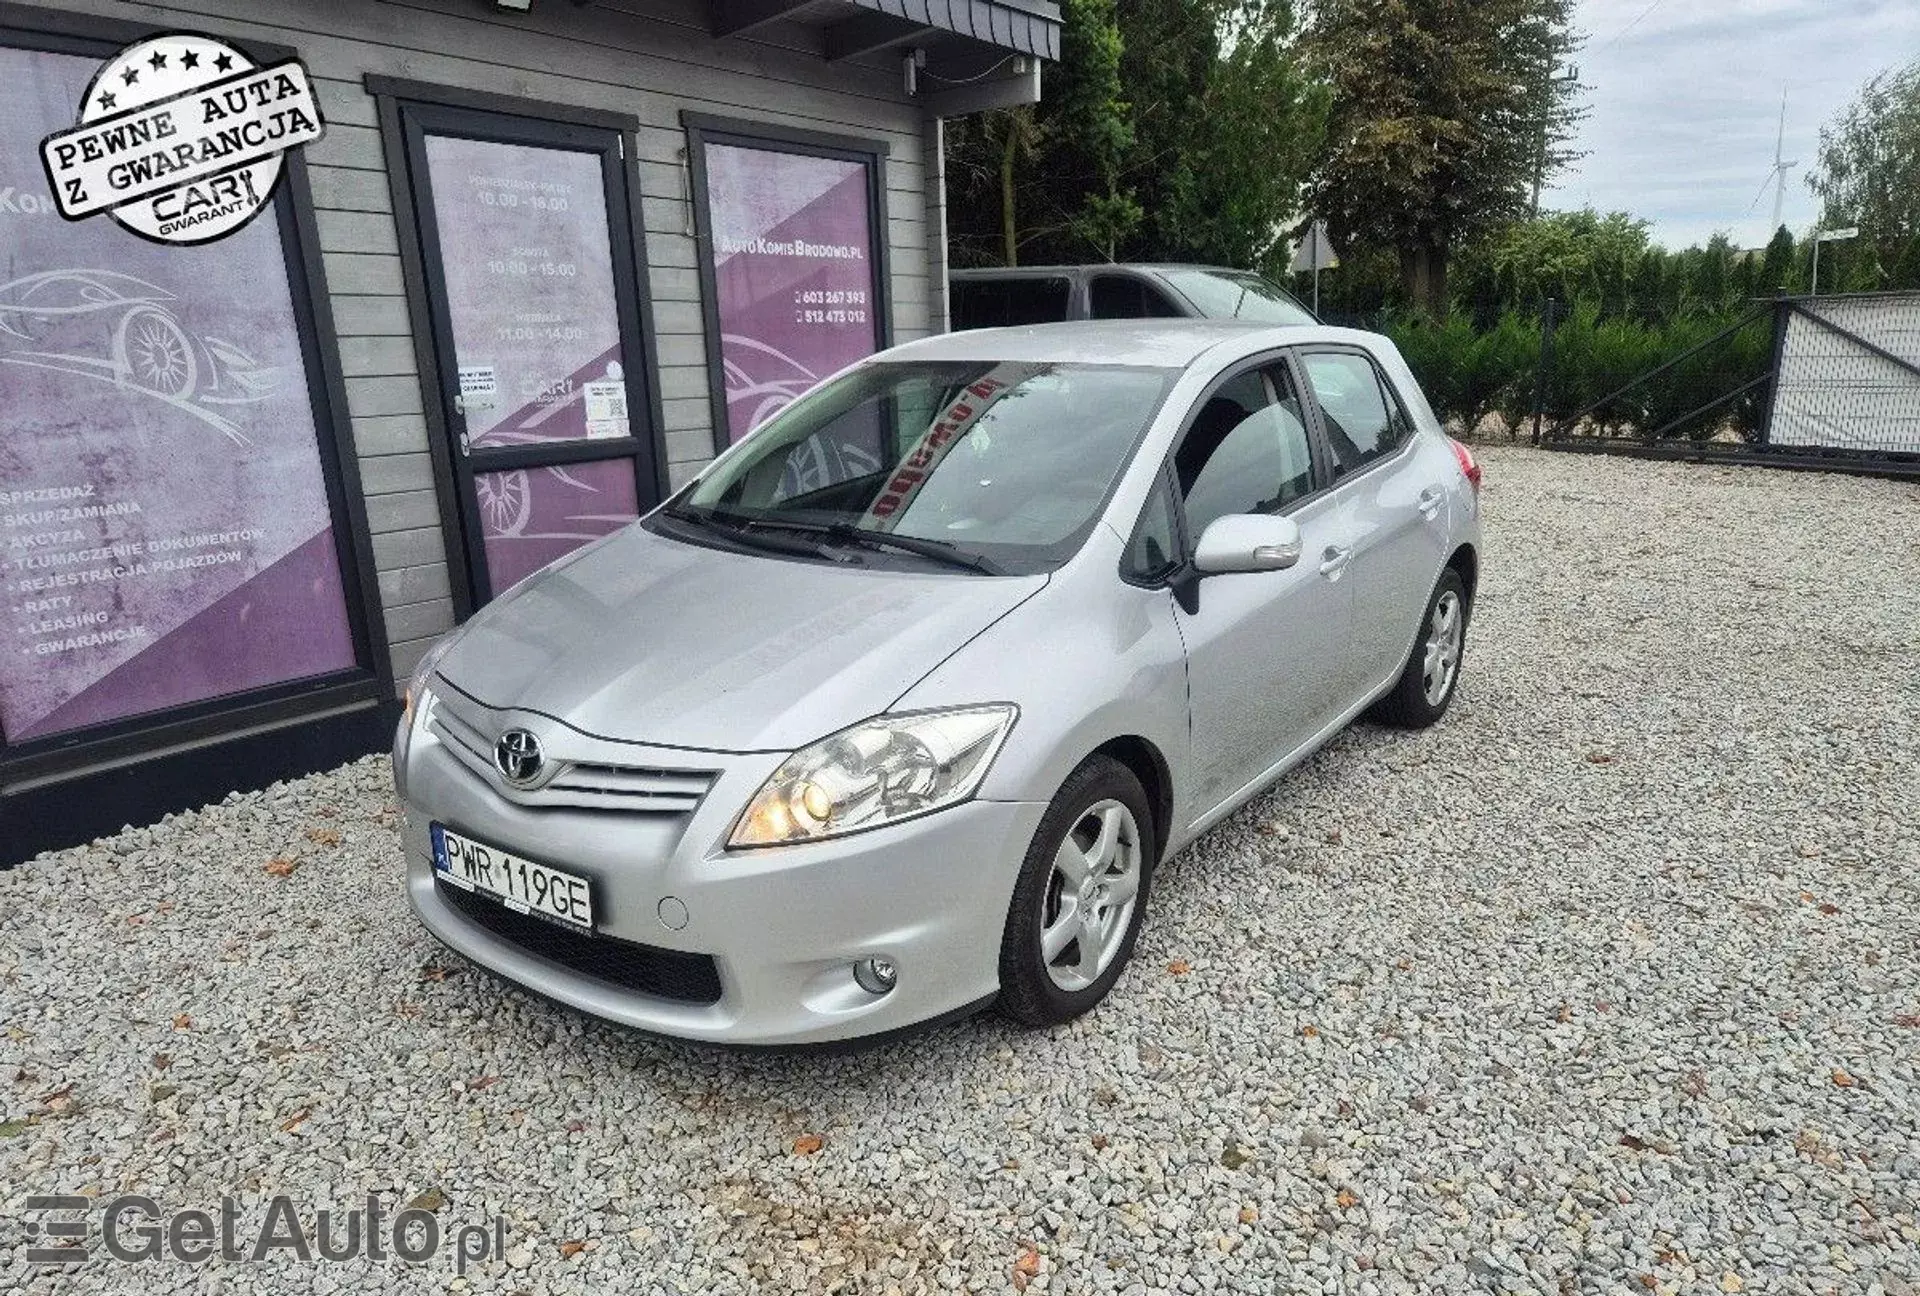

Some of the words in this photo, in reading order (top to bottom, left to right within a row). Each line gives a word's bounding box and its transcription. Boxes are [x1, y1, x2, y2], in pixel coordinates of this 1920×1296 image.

[803, 291, 823, 304] 603
[20, 563, 148, 592] REJESTRACJA
[24, 595, 72, 613] RATY
[30, 610, 109, 634] LEASING
[445, 834, 494, 888] PWR
[502, 857, 589, 923] 119GE
